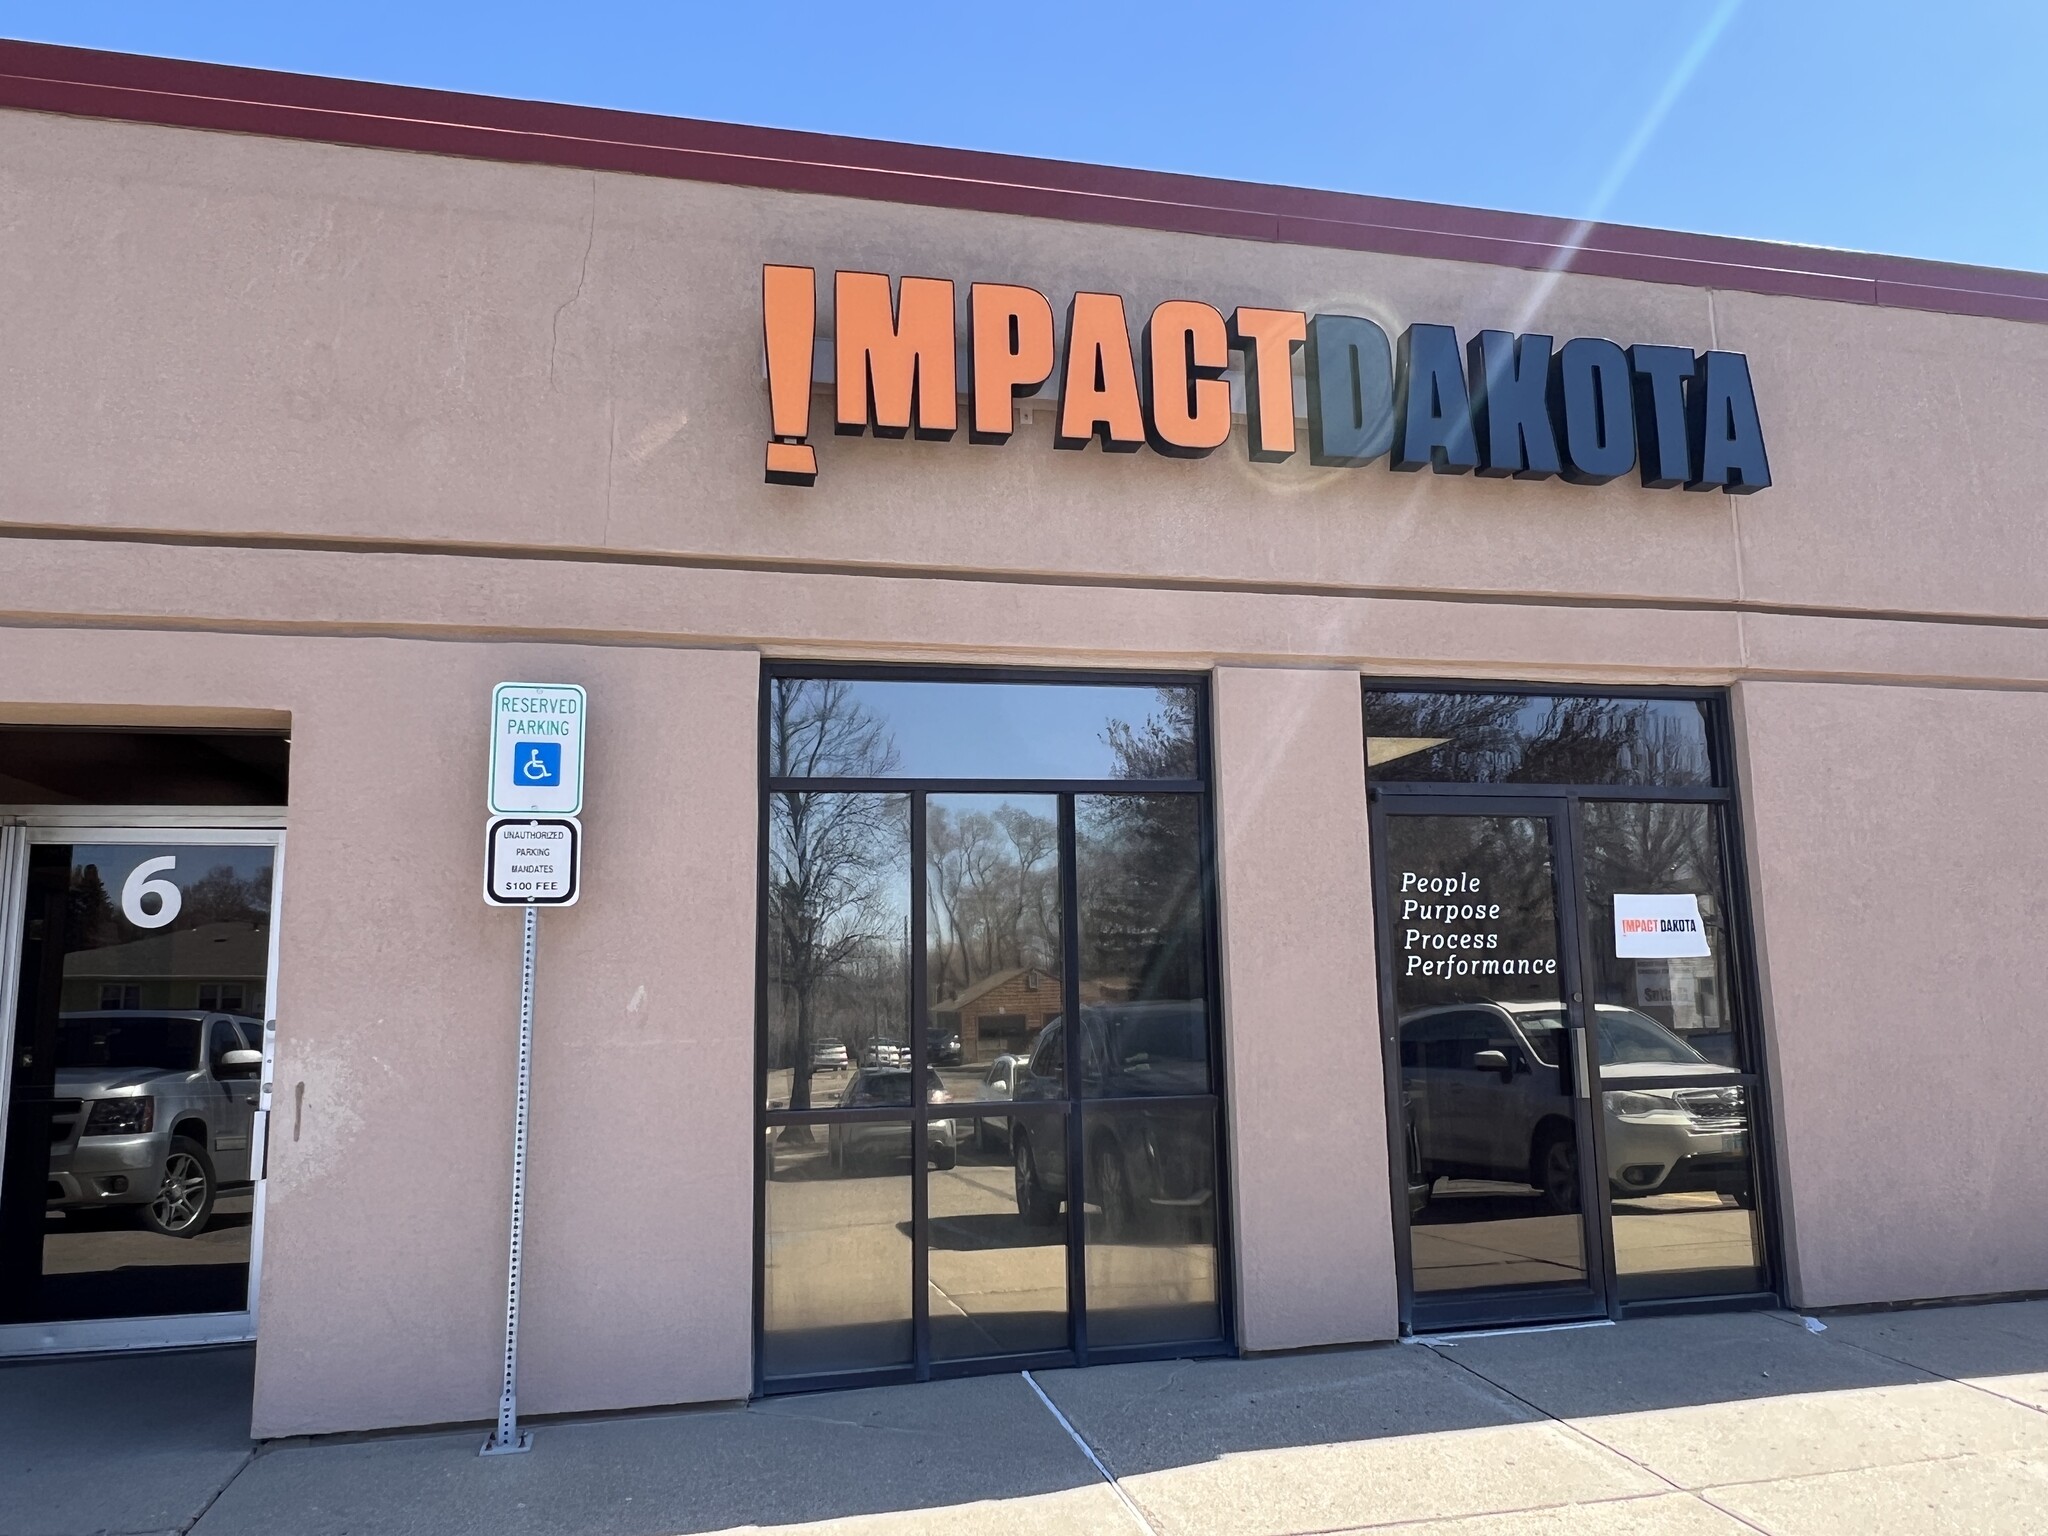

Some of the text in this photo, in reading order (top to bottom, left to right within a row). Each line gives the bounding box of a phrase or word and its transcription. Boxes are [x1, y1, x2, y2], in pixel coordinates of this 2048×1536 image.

[501, 697, 577, 714] RESERVED
[507, 719, 569, 736] PARKING
[503, 831, 564, 840] UNAUTHORIZED
[516, 848, 550, 857] PARKING
[511, 865, 554, 873] MANDATES
[121, 855, 182, 929] 6
[505, 882, 558, 890] $100 FEE
[1401, 872, 1481, 897] People
[1402, 900, 1500, 924] Purpose
[1660, 919, 1697, 932] DAKOTA
[1404, 929, 1498, 950] Process
[1406, 954, 1557, 980] Performance
